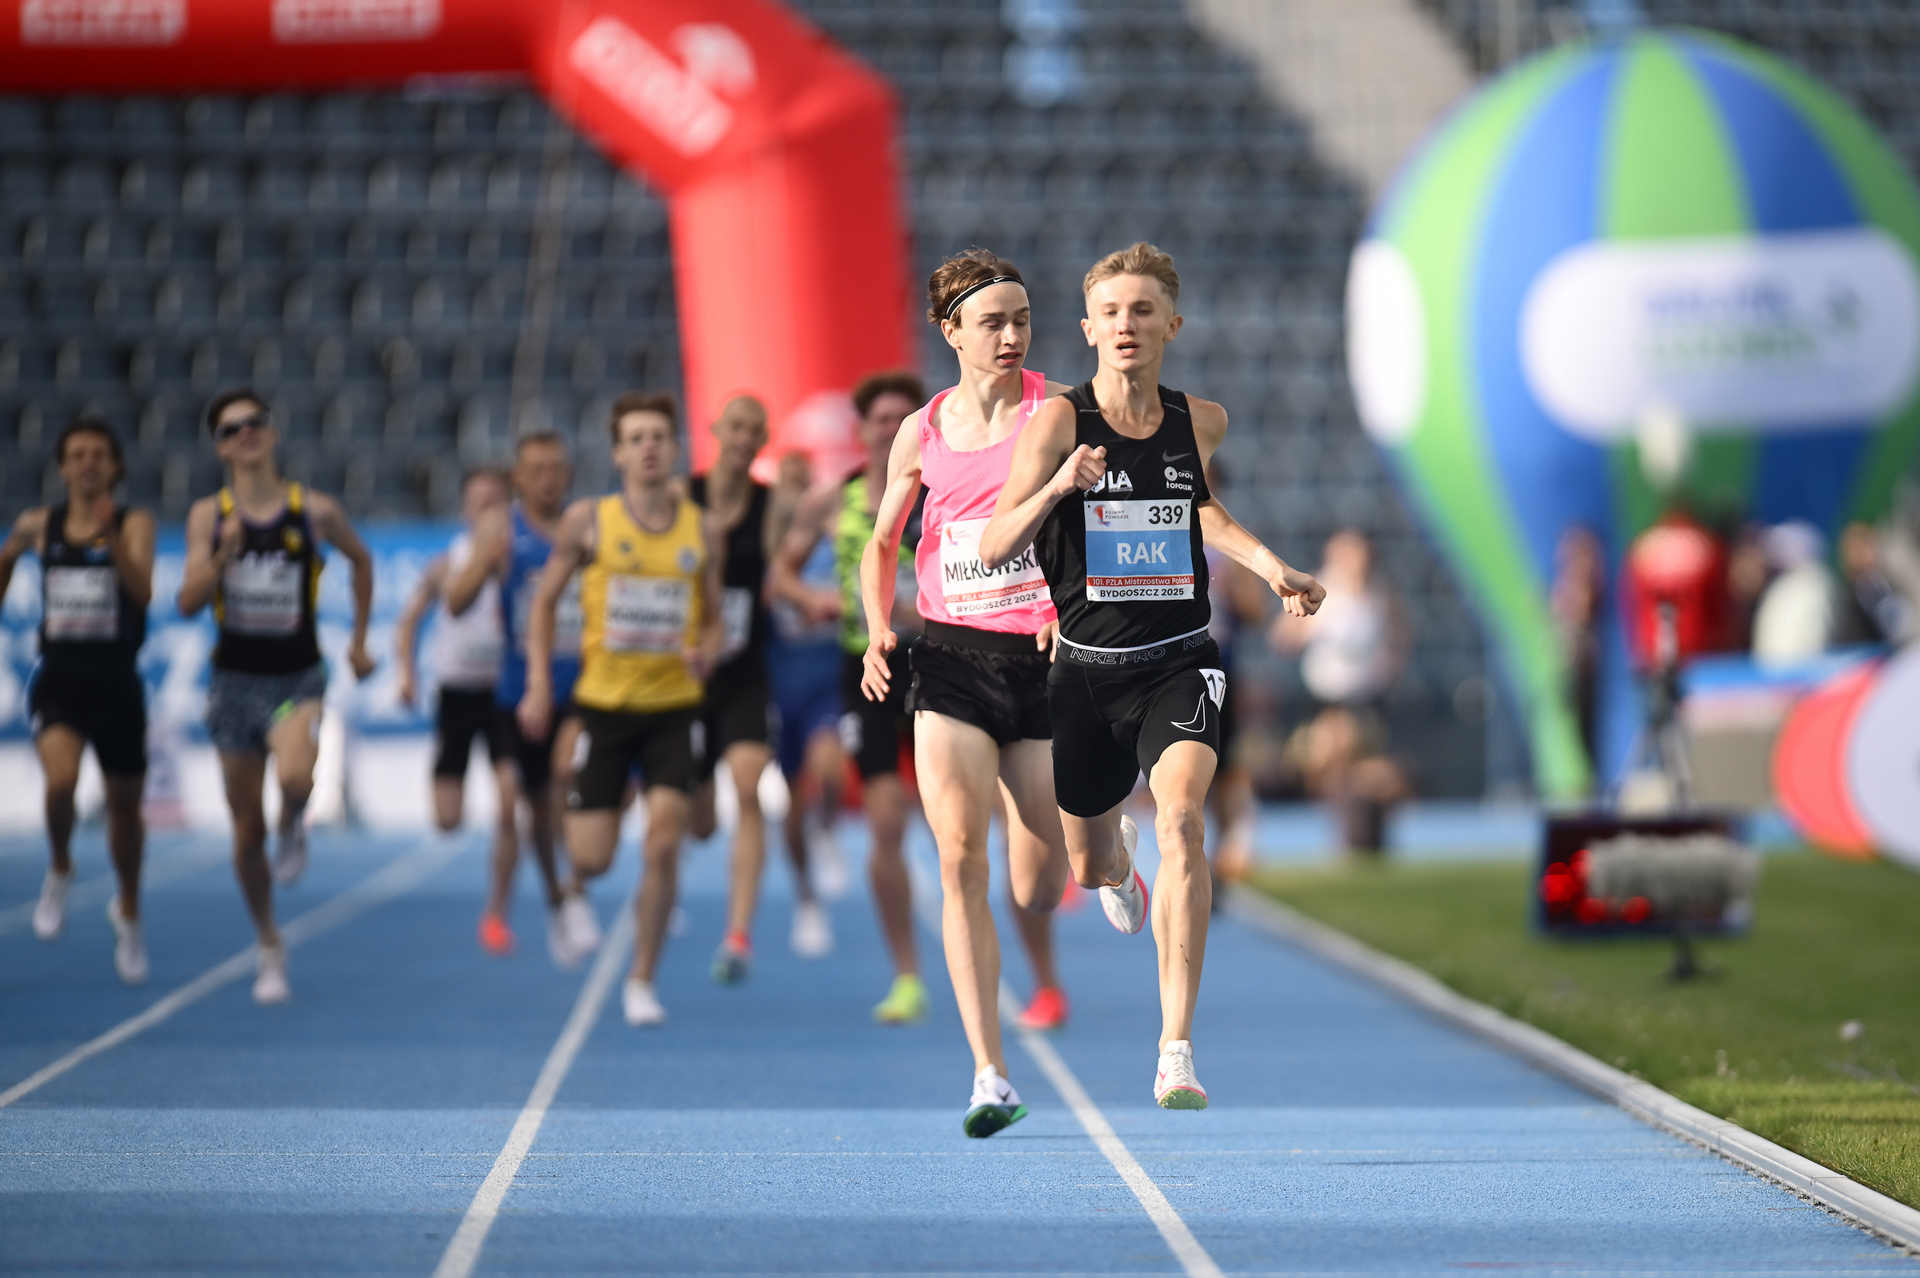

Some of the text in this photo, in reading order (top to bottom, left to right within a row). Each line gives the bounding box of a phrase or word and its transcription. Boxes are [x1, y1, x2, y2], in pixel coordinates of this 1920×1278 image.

[1148, 505, 1183, 524] 339
[1117, 541, 1167, 564] RAK
[978, 587, 1021, 599] Mistrzostwa
[1021, 580, 1044, 590] Polski
[1124, 577, 1170, 585] Mistrzostwa
[957, 592, 1038, 612] BYDGOSZCZ 2025
[1100, 588, 1184, 597] BYDGOSZCZ 2025
[1070, 648, 1119, 664] NIKE
[1119, 646, 1166, 665] PRO
[1206, 673, 1226, 703] 17
